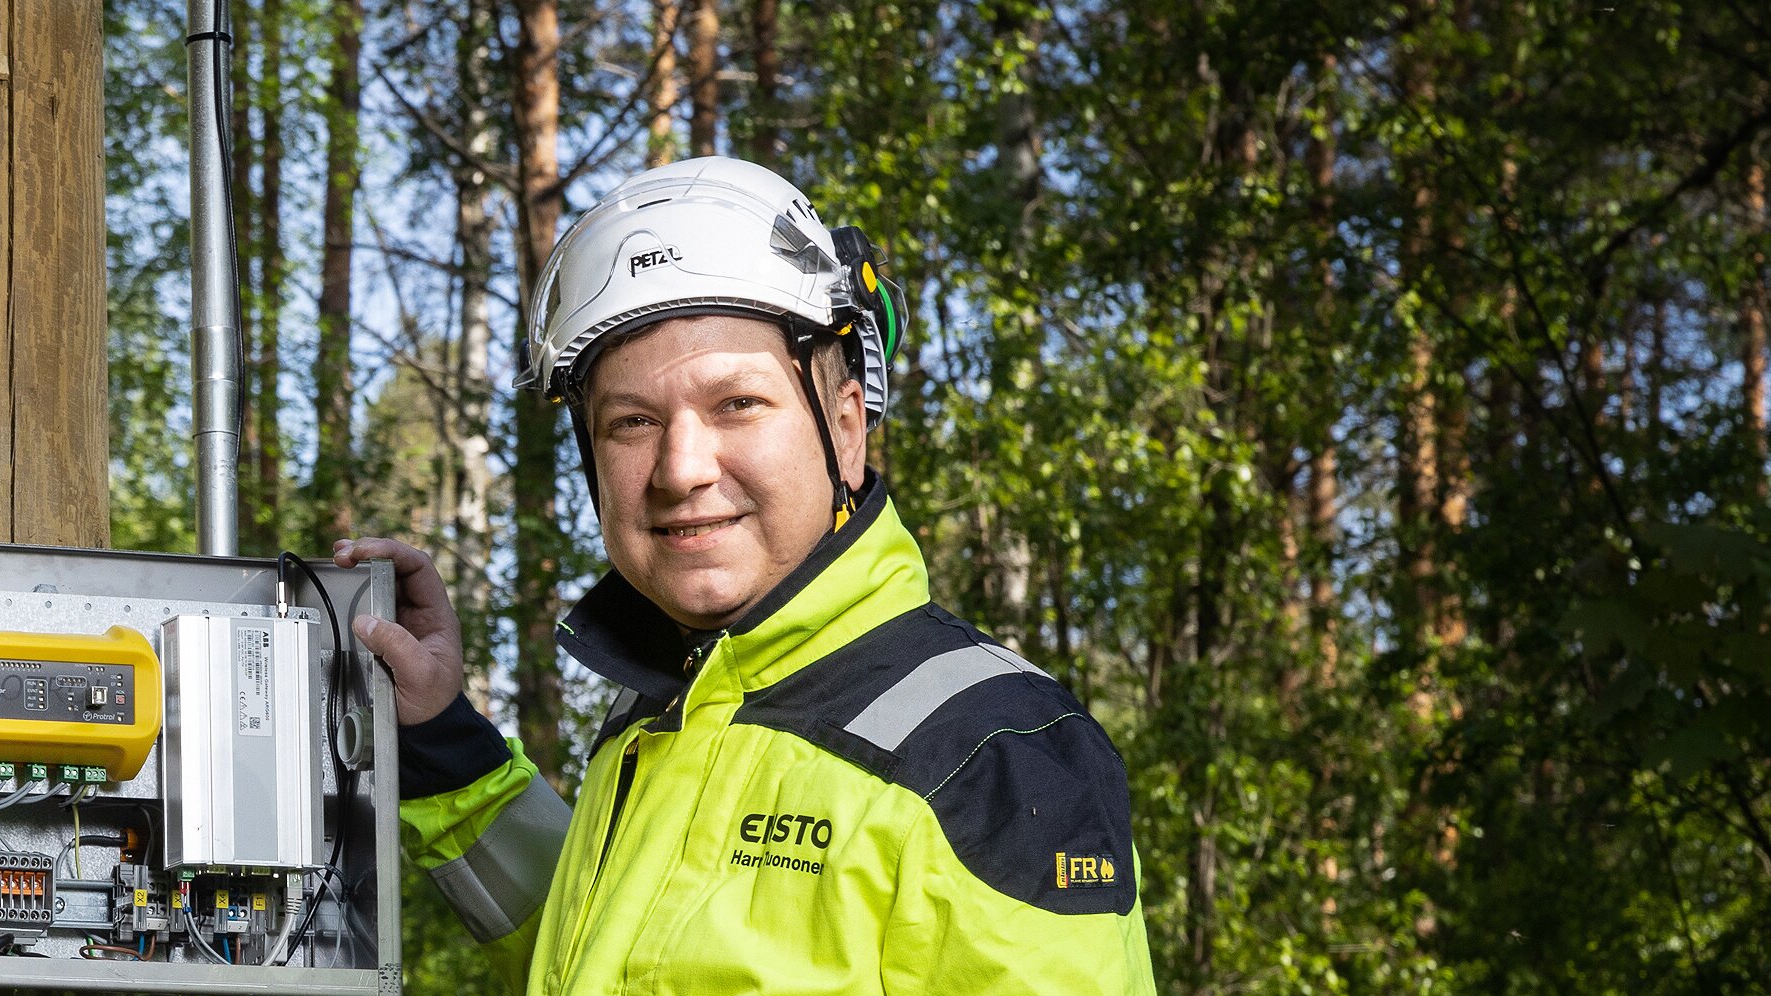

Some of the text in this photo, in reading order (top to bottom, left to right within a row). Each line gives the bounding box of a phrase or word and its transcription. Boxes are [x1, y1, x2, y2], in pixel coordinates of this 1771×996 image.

[93, 712, 115, 721] Protrol
[730, 849, 764, 868] Harr
[1070, 857, 1099, 879] FR
[137, 892, 144, 903] X2
[219, 894, 226, 904] X4
[255, 897, 263, 906] F1
